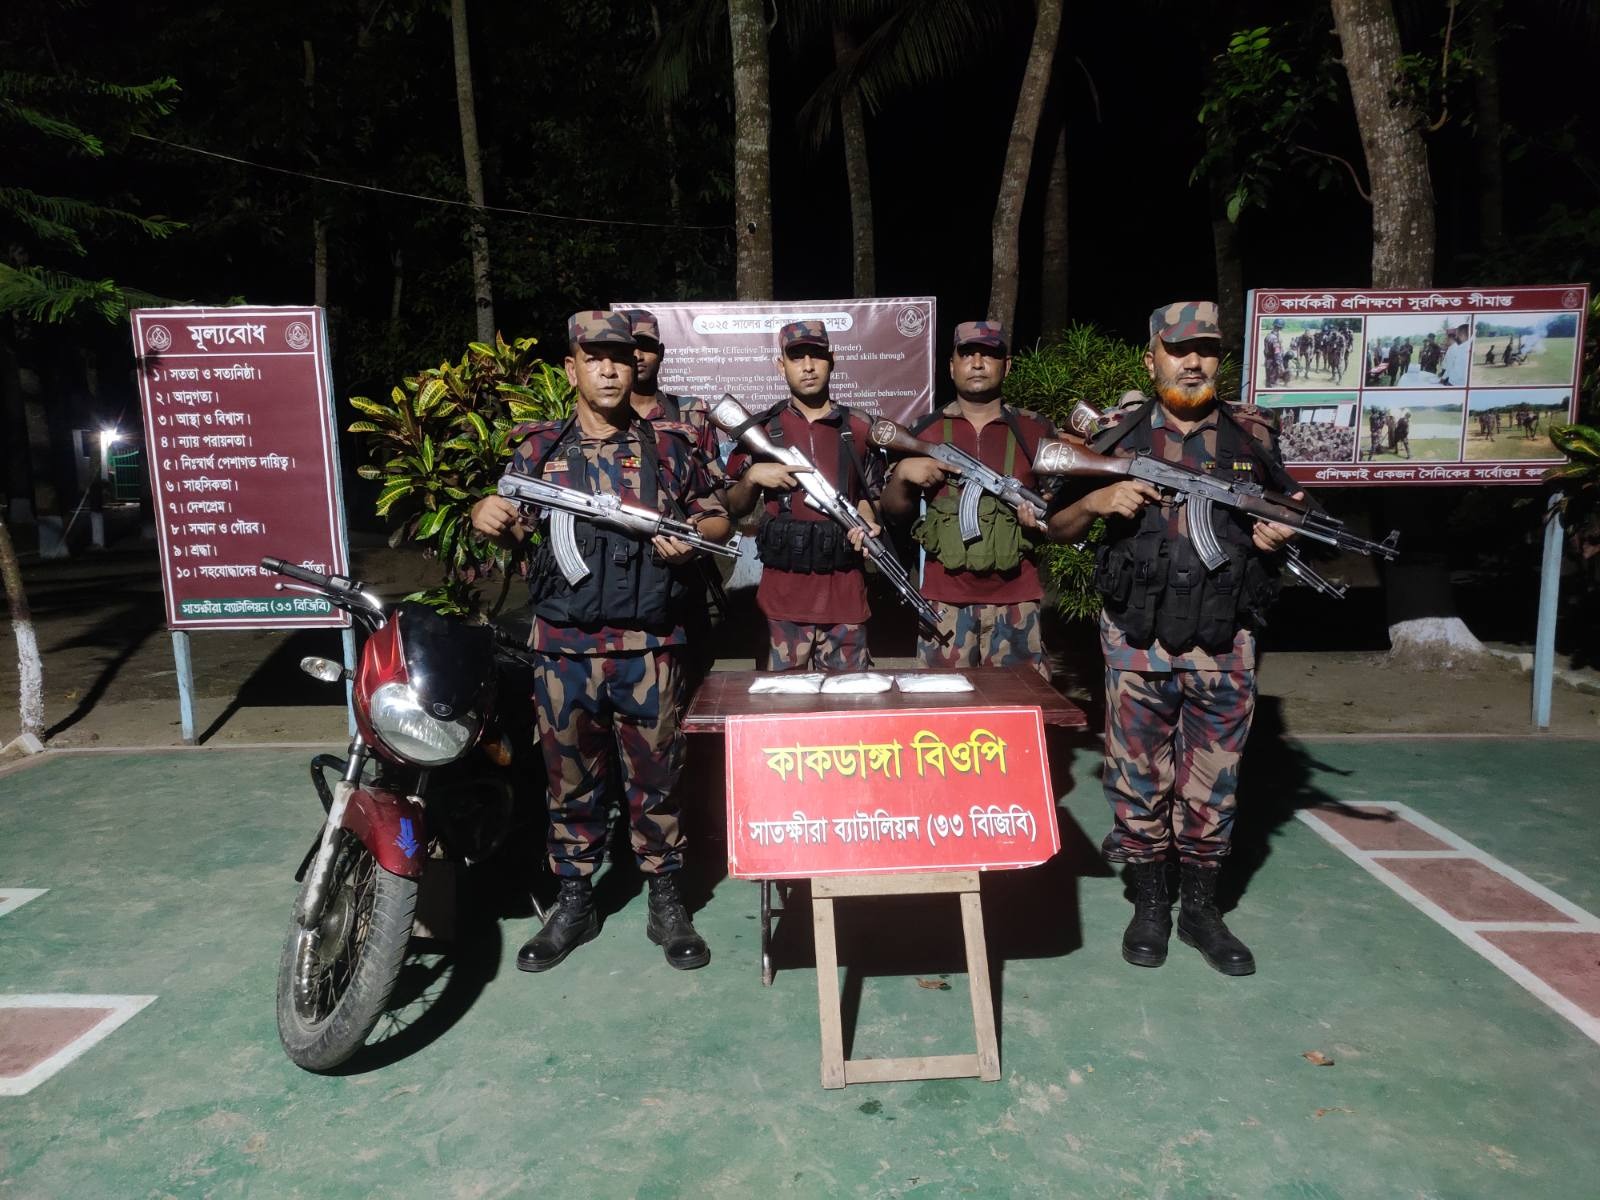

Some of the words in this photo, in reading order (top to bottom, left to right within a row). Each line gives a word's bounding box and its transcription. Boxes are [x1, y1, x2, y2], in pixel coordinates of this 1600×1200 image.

[1280, 294, 1338, 310] কার্যকরী
[1340, 294, 1404, 310] প্রশিক্ষণে
[1407, 293, 1464, 311] সুরক্ষিত
[1467, 292, 1515, 308] সীমান্ত
[187, 323, 267, 351] মূল্যবোধ
[880, 351, 905, 361] through
[169, 368, 200, 381] সততা
[202, 369, 212, 380] ও
[175, 413, 201, 428] আস্থা
[203, 414, 213, 425] ও
[218, 456, 257, 470] পেশাগত
[1315, 468, 1370, 480] প্রশিক্ষণই
[1373, 469, 1416, 479] একজন
[1418, 466, 1471, 479] সৈনিকের
[1474, 465, 1522, 478] সর্বোত্তম
[188, 522, 216, 535] সম্মান
[218, 523, 228, 534] ও
[182, 600, 222, 614] সাতক্ষীরা
[223, 599, 269, 613] ব্যাটালিয়ন
[270, 601, 292, 613] (৩৩
[293, 598, 332, 613] বিজিবি)
[763, 739, 903, 783] কাকডাঙ্গা
[911, 728, 1008, 777] বিওপি
[748, 811, 828, 846] সাতক্ষীরা
[833, 808, 920, 843] ব্যাটালিয়ন
[927, 813, 964, 846] (৩৩
[968, 804, 1037, 842] বিজিবি)
